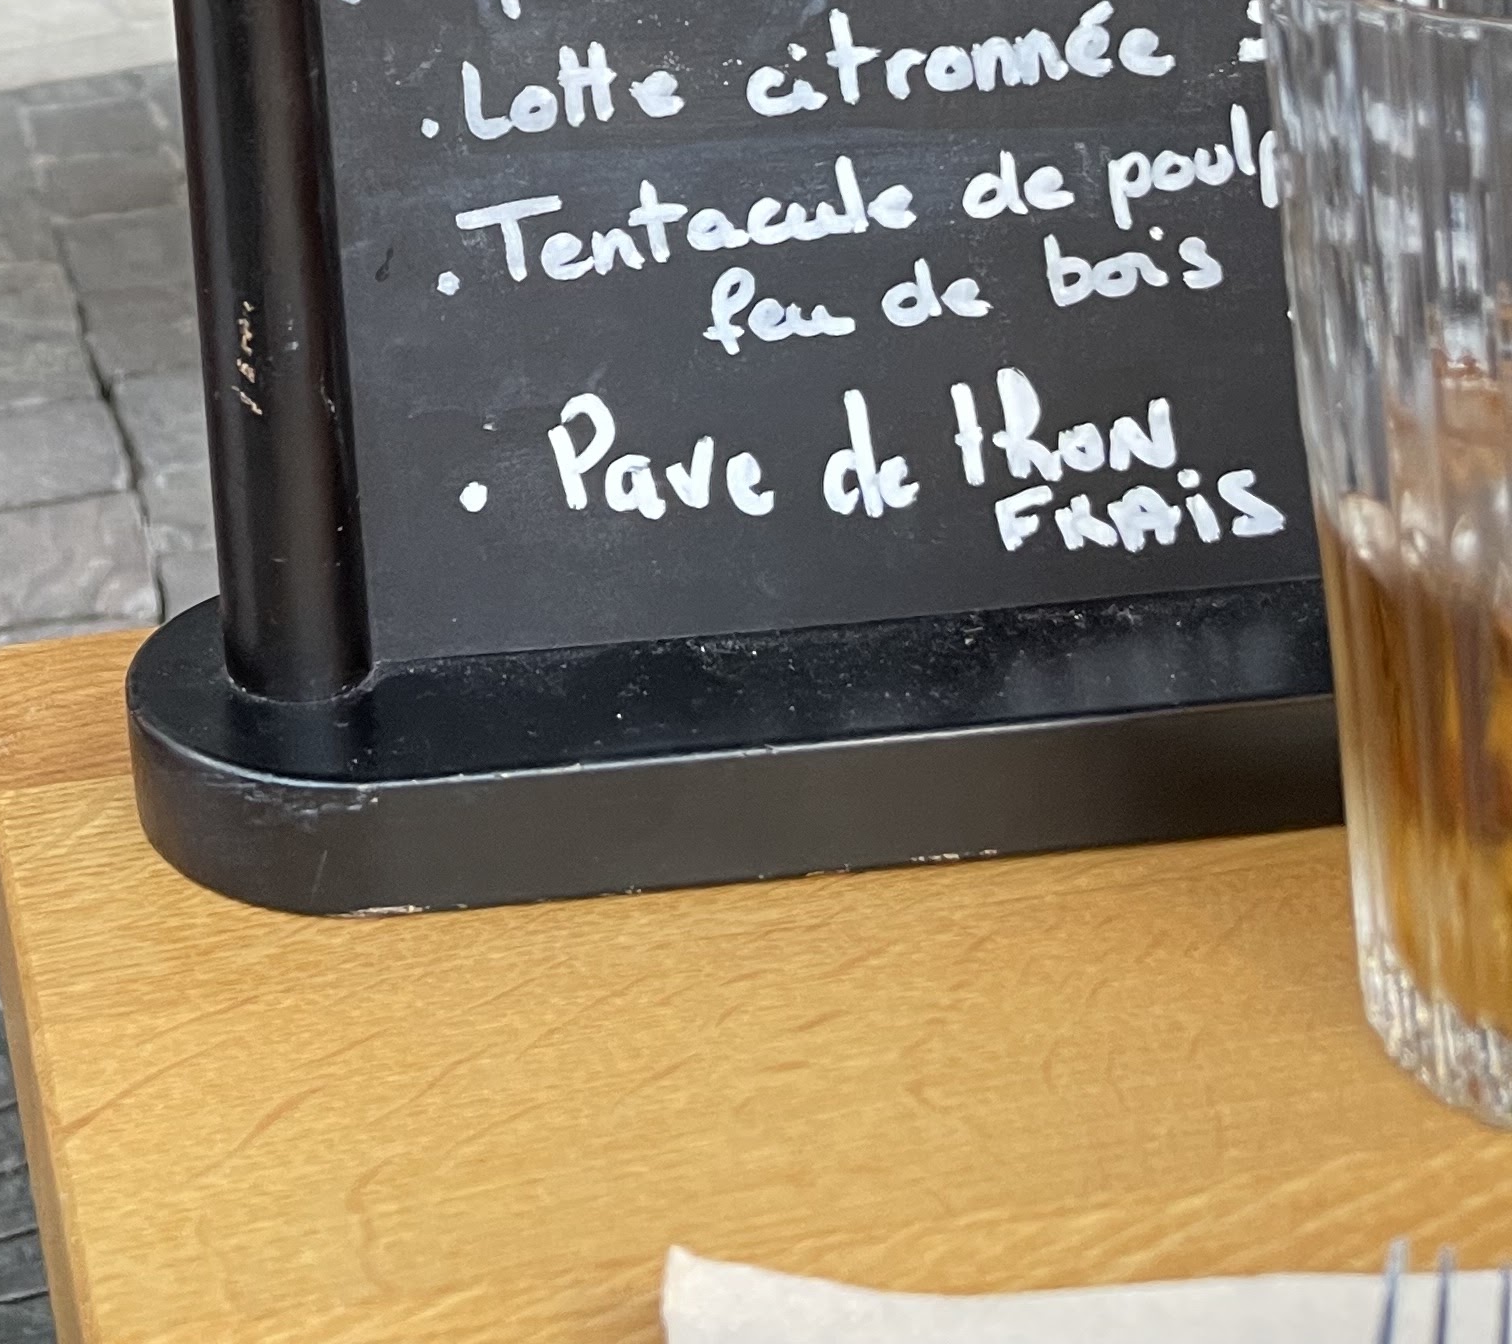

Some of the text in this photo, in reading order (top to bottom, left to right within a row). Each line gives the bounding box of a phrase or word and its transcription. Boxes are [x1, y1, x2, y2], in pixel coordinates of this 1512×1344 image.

[461, 40, 687, 141] Lotte
[747, 0, 1177, 119] citronnée
[455, 154, 919, 282] Tentacule
[962, 149, 1076, 220] de
[702, 226, 1225, 356] feu de bois
[823, 388, 921, 518] de
